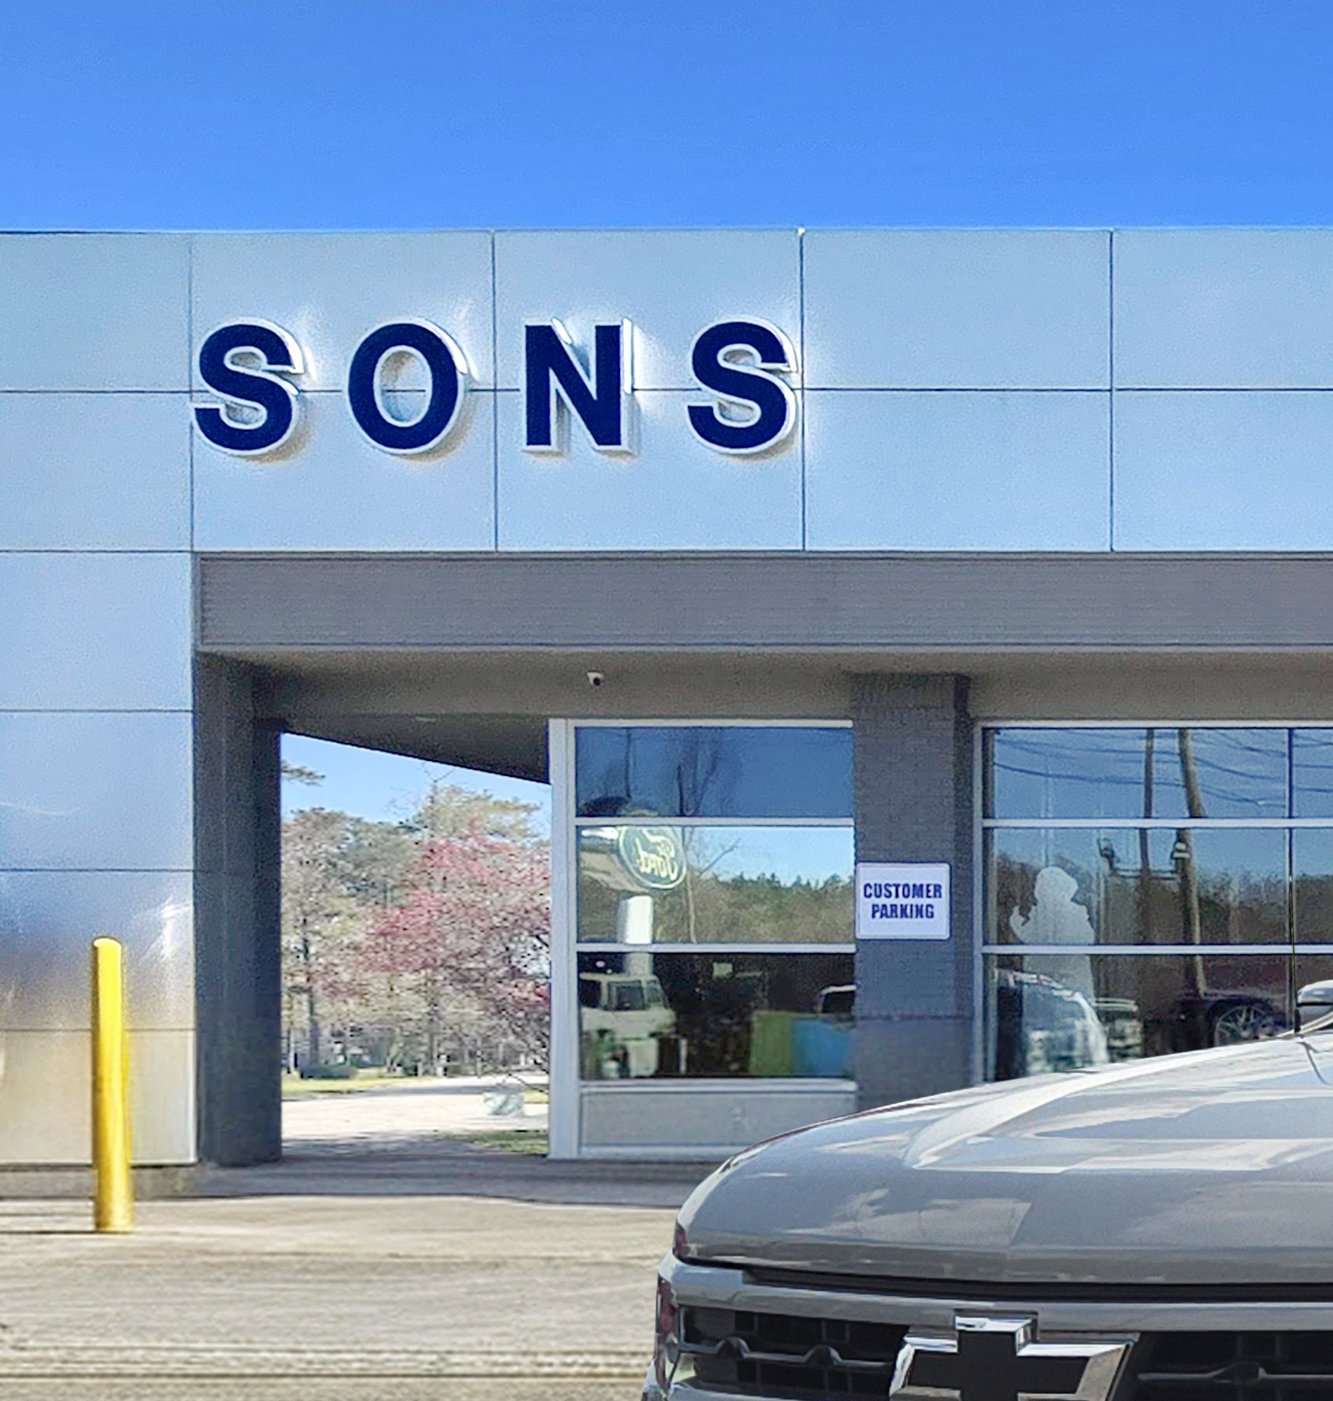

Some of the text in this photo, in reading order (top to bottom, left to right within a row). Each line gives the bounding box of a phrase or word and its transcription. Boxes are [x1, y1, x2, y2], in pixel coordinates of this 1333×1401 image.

[193, 319, 797, 453] SONS
[863, 882, 943, 899] CUSTOMER
[871, 903, 935, 920] PARKING
